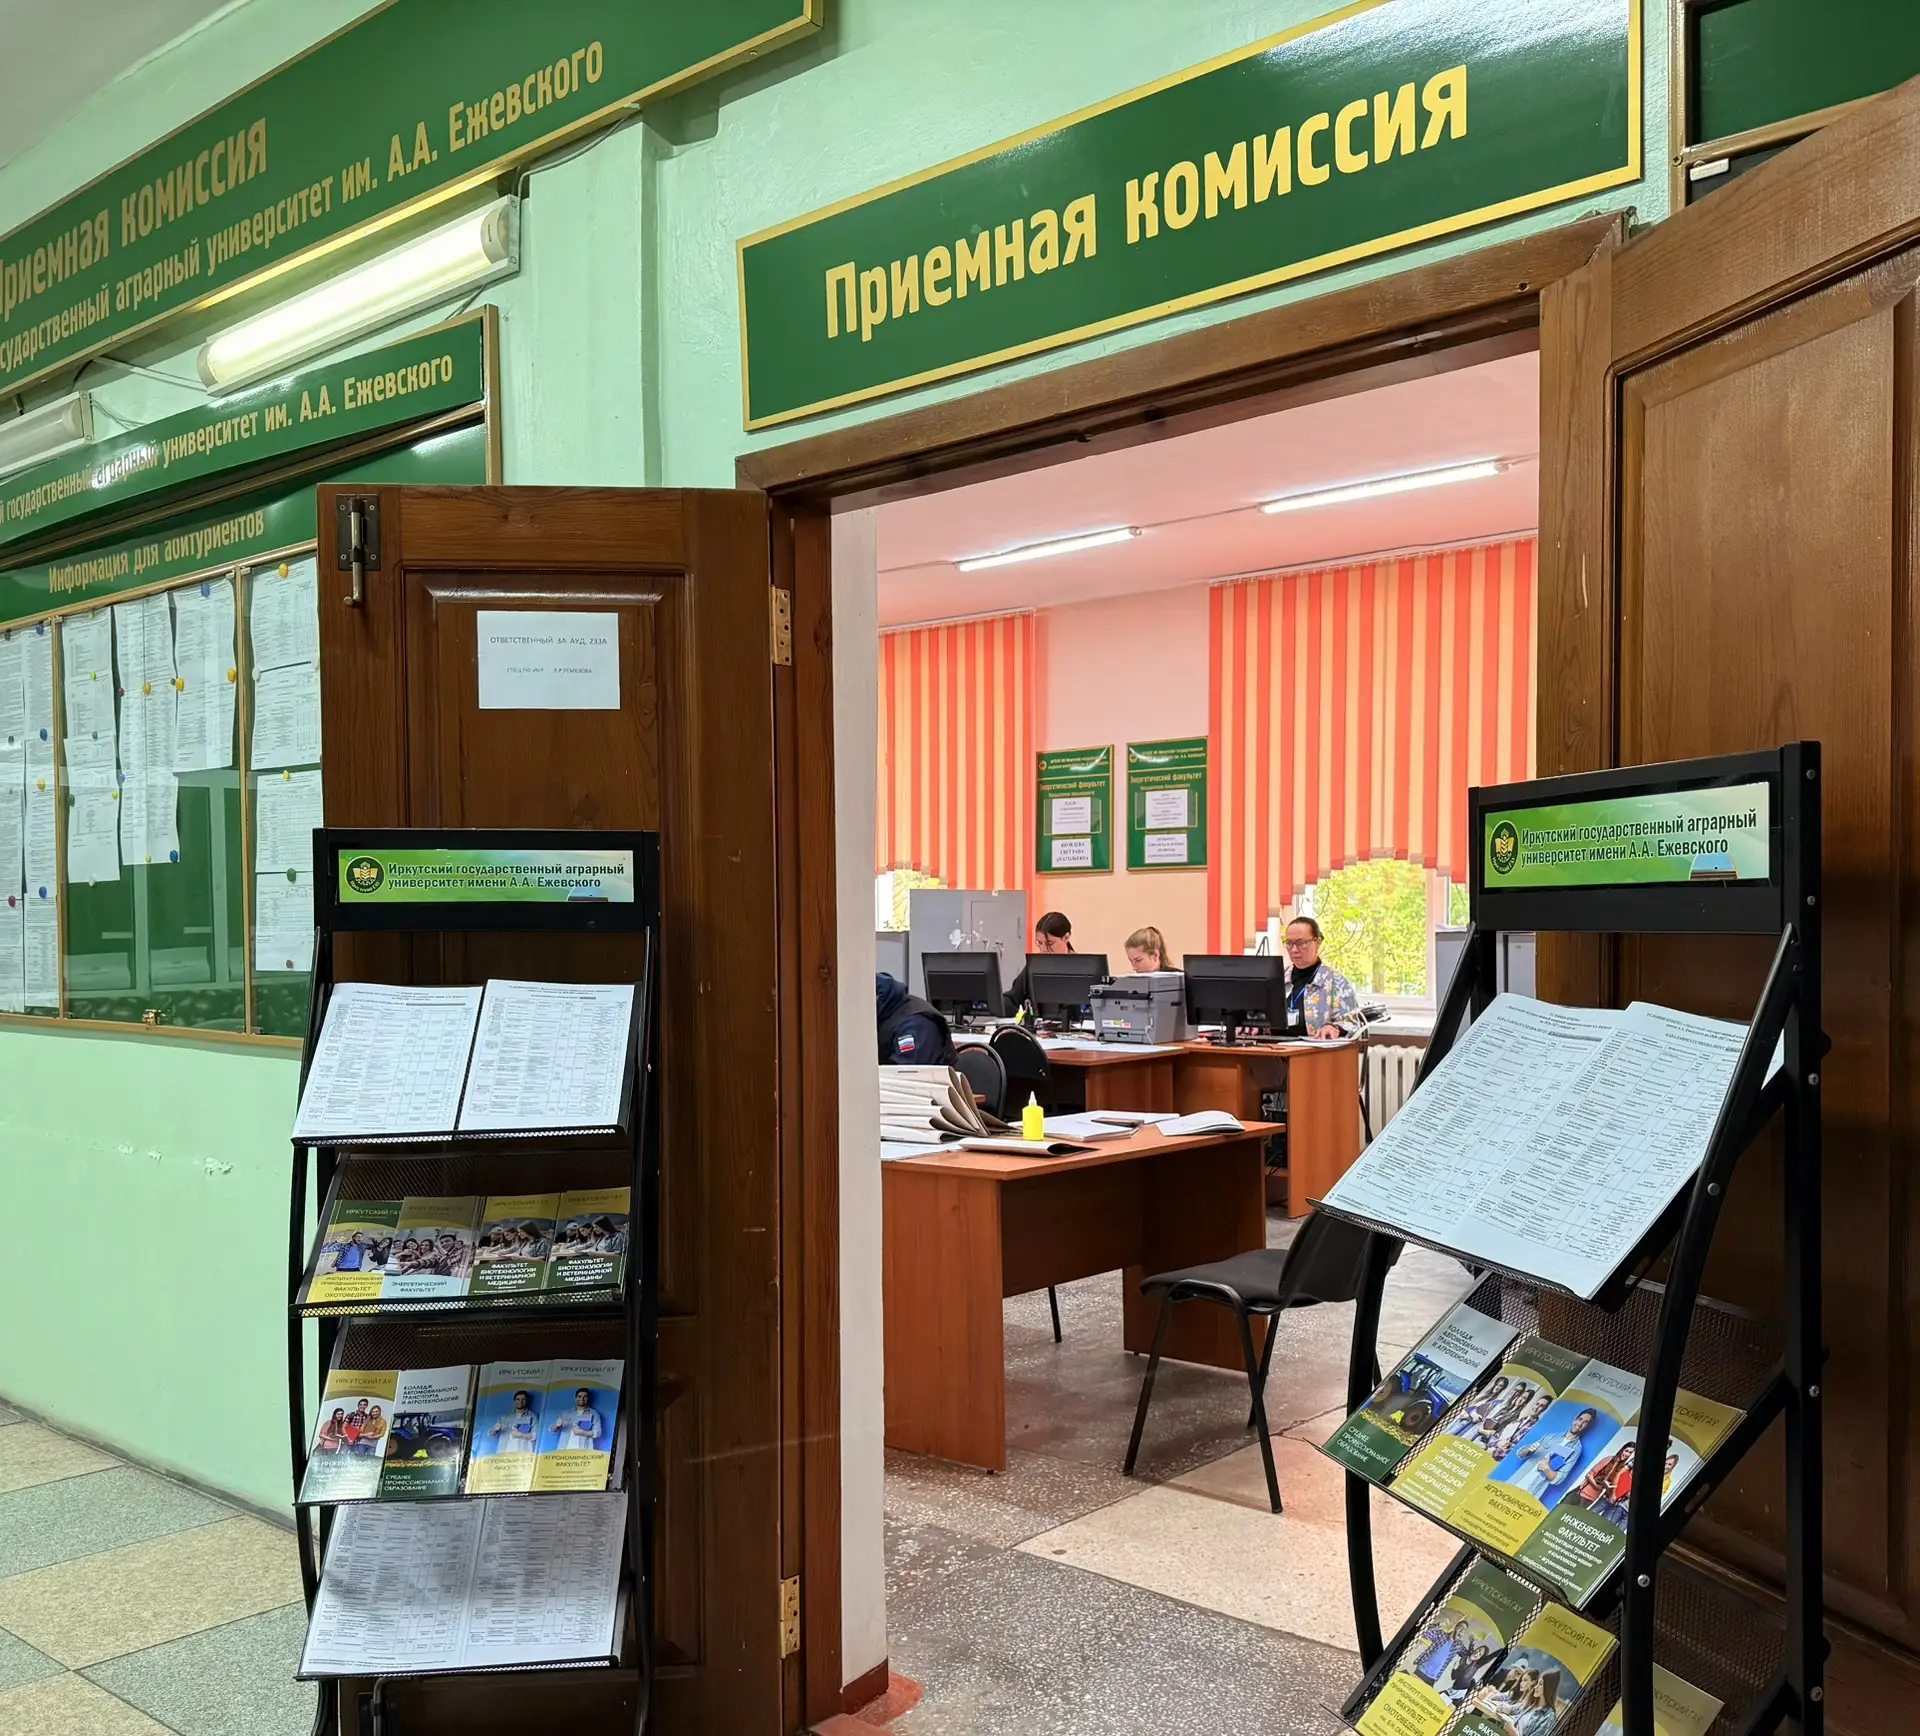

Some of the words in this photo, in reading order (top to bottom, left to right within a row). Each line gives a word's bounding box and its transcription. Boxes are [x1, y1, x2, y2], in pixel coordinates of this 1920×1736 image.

[116, 237, 200, 312] аграрный
[206, 176, 333, 276] университет
[342, 165, 378, 204] им.
[388, 121, 438, 181] А.А.
[449, 41, 604, 153] Ежевского
[121, 118, 268, 248] комиссия
[826, 193, 1097, 342] Приемная
[1126, 64, 1467, 245] комиссия
[7, 464, 92, 521] государственный
[162, 410, 258, 469] университет
[265, 403, 293, 430] им.
[300, 385, 337, 422] А.А.
[344, 355, 453, 409] Ежевского
[49, 552, 128, 595] Информация
[134, 540, 159, 574] для
[490, 636, 553, 644] ОТВЕТСТВЕННЫЙ
[1521, 823, 1576, 847] Иркутский
[1579, 815, 1684, 842] государственный
[1687, 808, 1757, 834] аграрный
[1521, 848, 1586, 868] университет
[1589, 846, 1626, 861] имени
[1629, 843, 1654, 859] А.А.
[1657, 836, 1728, 858] Ежевского
[388, 863, 453, 878] Иркутский
[456, 863, 562, 877] государственный
[565, 863, 624, 877] аграрный
[388, 877, 465, 889] университет
[467, 877, 507, 888] имени
[509, 877, 534, 888] А.А.
[537, 876, 601, 888] Ежевского
[557, 1262, 613, 1271] БИОТЕХНОЛОГИИ
[563, 1268, 612, 1276] ВЕТЕРИНАРНОЙ
[1525, 1347, 1563, 1369] ИРКУТСКИЙ
[1561, 1360, 1577, 1372] ГАУ
[403, 1386, 457, 1395] АВТОМОБИЛЬНОГО
[1588, 1371, 1631, 1392] ИРКУТСКИЙ
[1703, 1414, 1720, 1427] ГАУ
[1484, 1483, 1543, 1519] АГРОНОМИЧЕСКИЙ
[1488, 1499, 1522, 1521] ФАКУЛЬТЕТ
[1558, 1526, 1600, 1552] ФАКУЛЬТЕТ
[1560, 1513, 1615, 1545] ИНЖЕНЕРНЫЙ
[1472, 1575, 1511, 1606] ИРКУТСКИЙ
[1509, 1596, 1524, 1612] ГАУ
[1544, 1614, 1585, 1645] ИРКУТСКИЙ
[1583, 1634, 1599, 1650] ГАУ
[1396, 1699, 1427, 1725] ФАКУЛЬТЕТ
[1654, 1689, 1690, 1715] КУТСКИЙ
[1687, 1710, 1704, 1723] ГАУ
